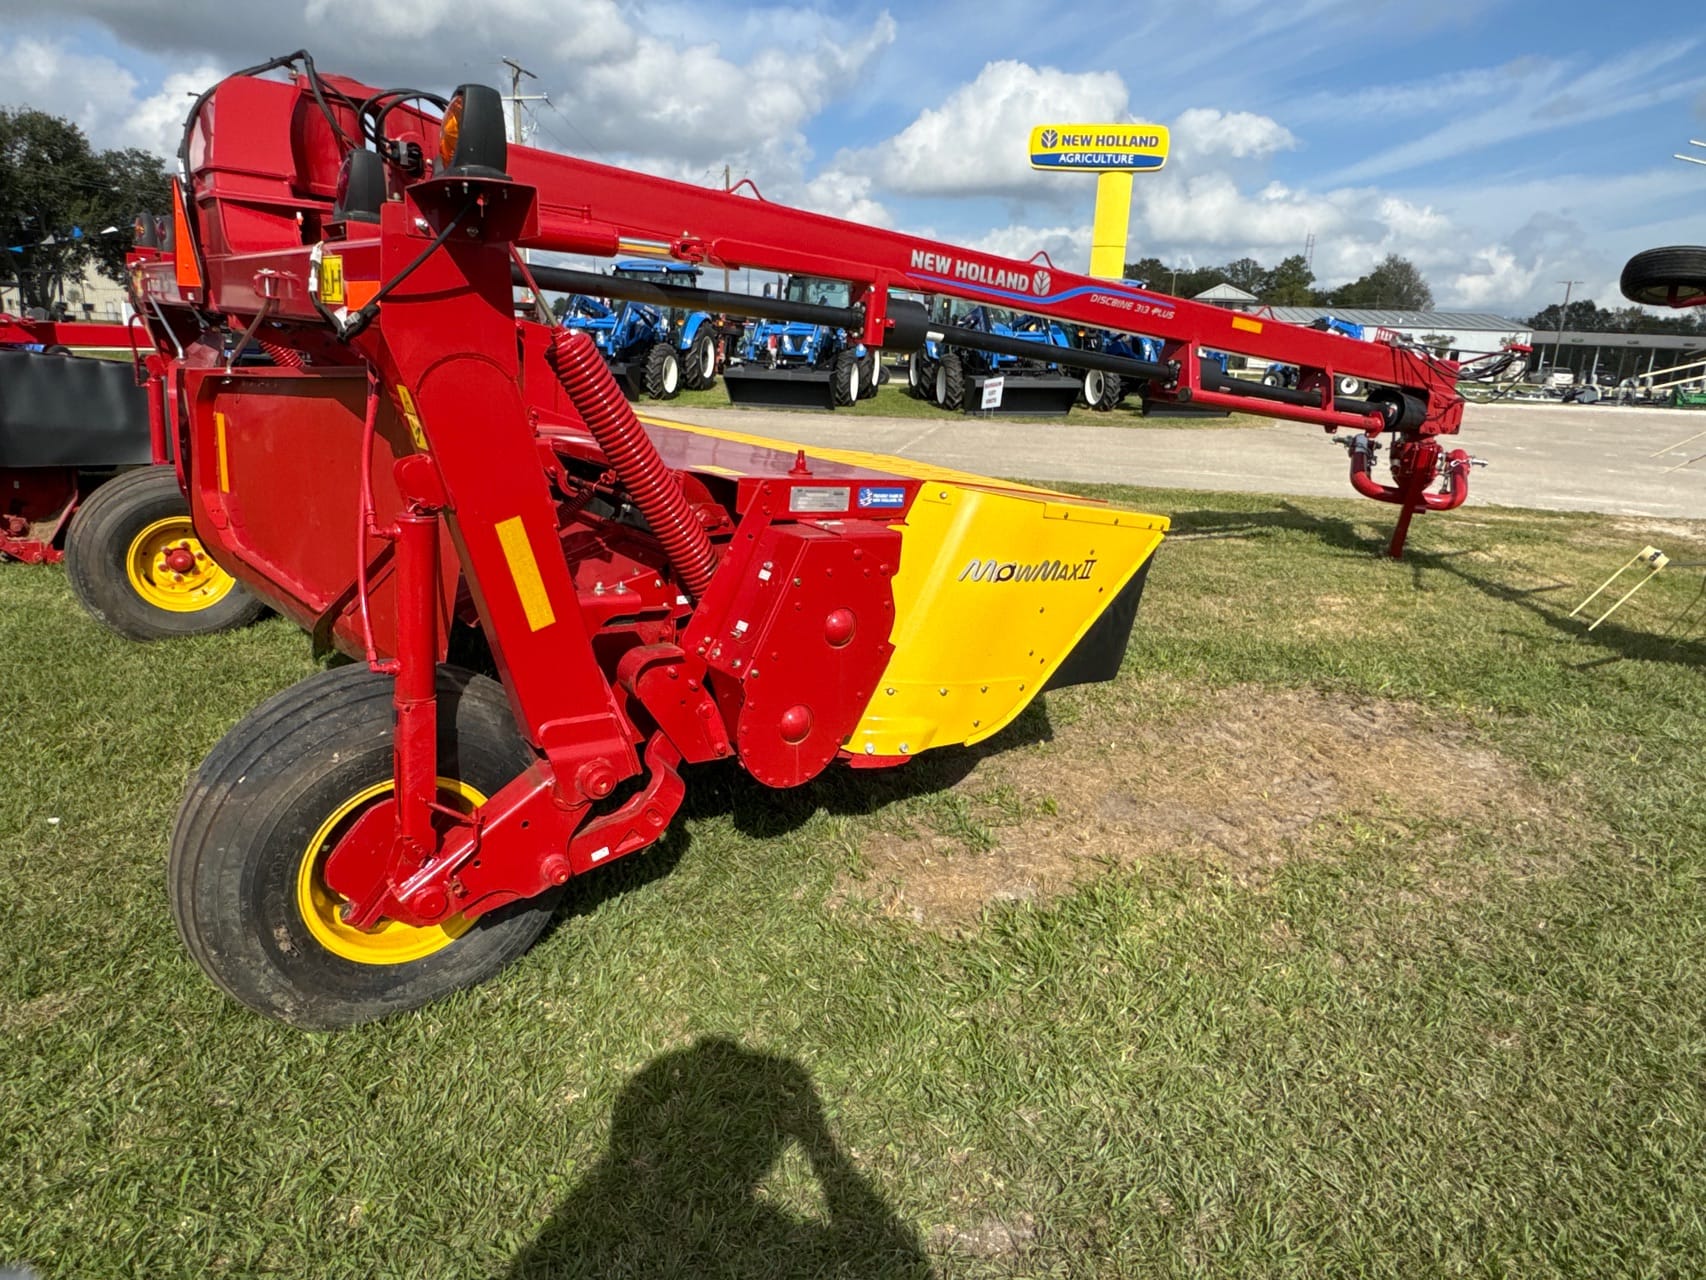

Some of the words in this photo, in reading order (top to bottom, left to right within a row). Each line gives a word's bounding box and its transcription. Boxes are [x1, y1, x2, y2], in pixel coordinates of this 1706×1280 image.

[1061, 134, 1093, 147] NEW
[1095, 135, 1159, 148] HOLLAND
[1058, 153, 1134, 165] AGRICULTURE
[910, 249, 952, 275] NEW
[955, 260, 1030, 292] HOLLAND
[1089, 293, 1134, 311] DISCBINE
[1134, 303, 1151, 314] 313
[1151, 307, 1176, 320] PLUS
